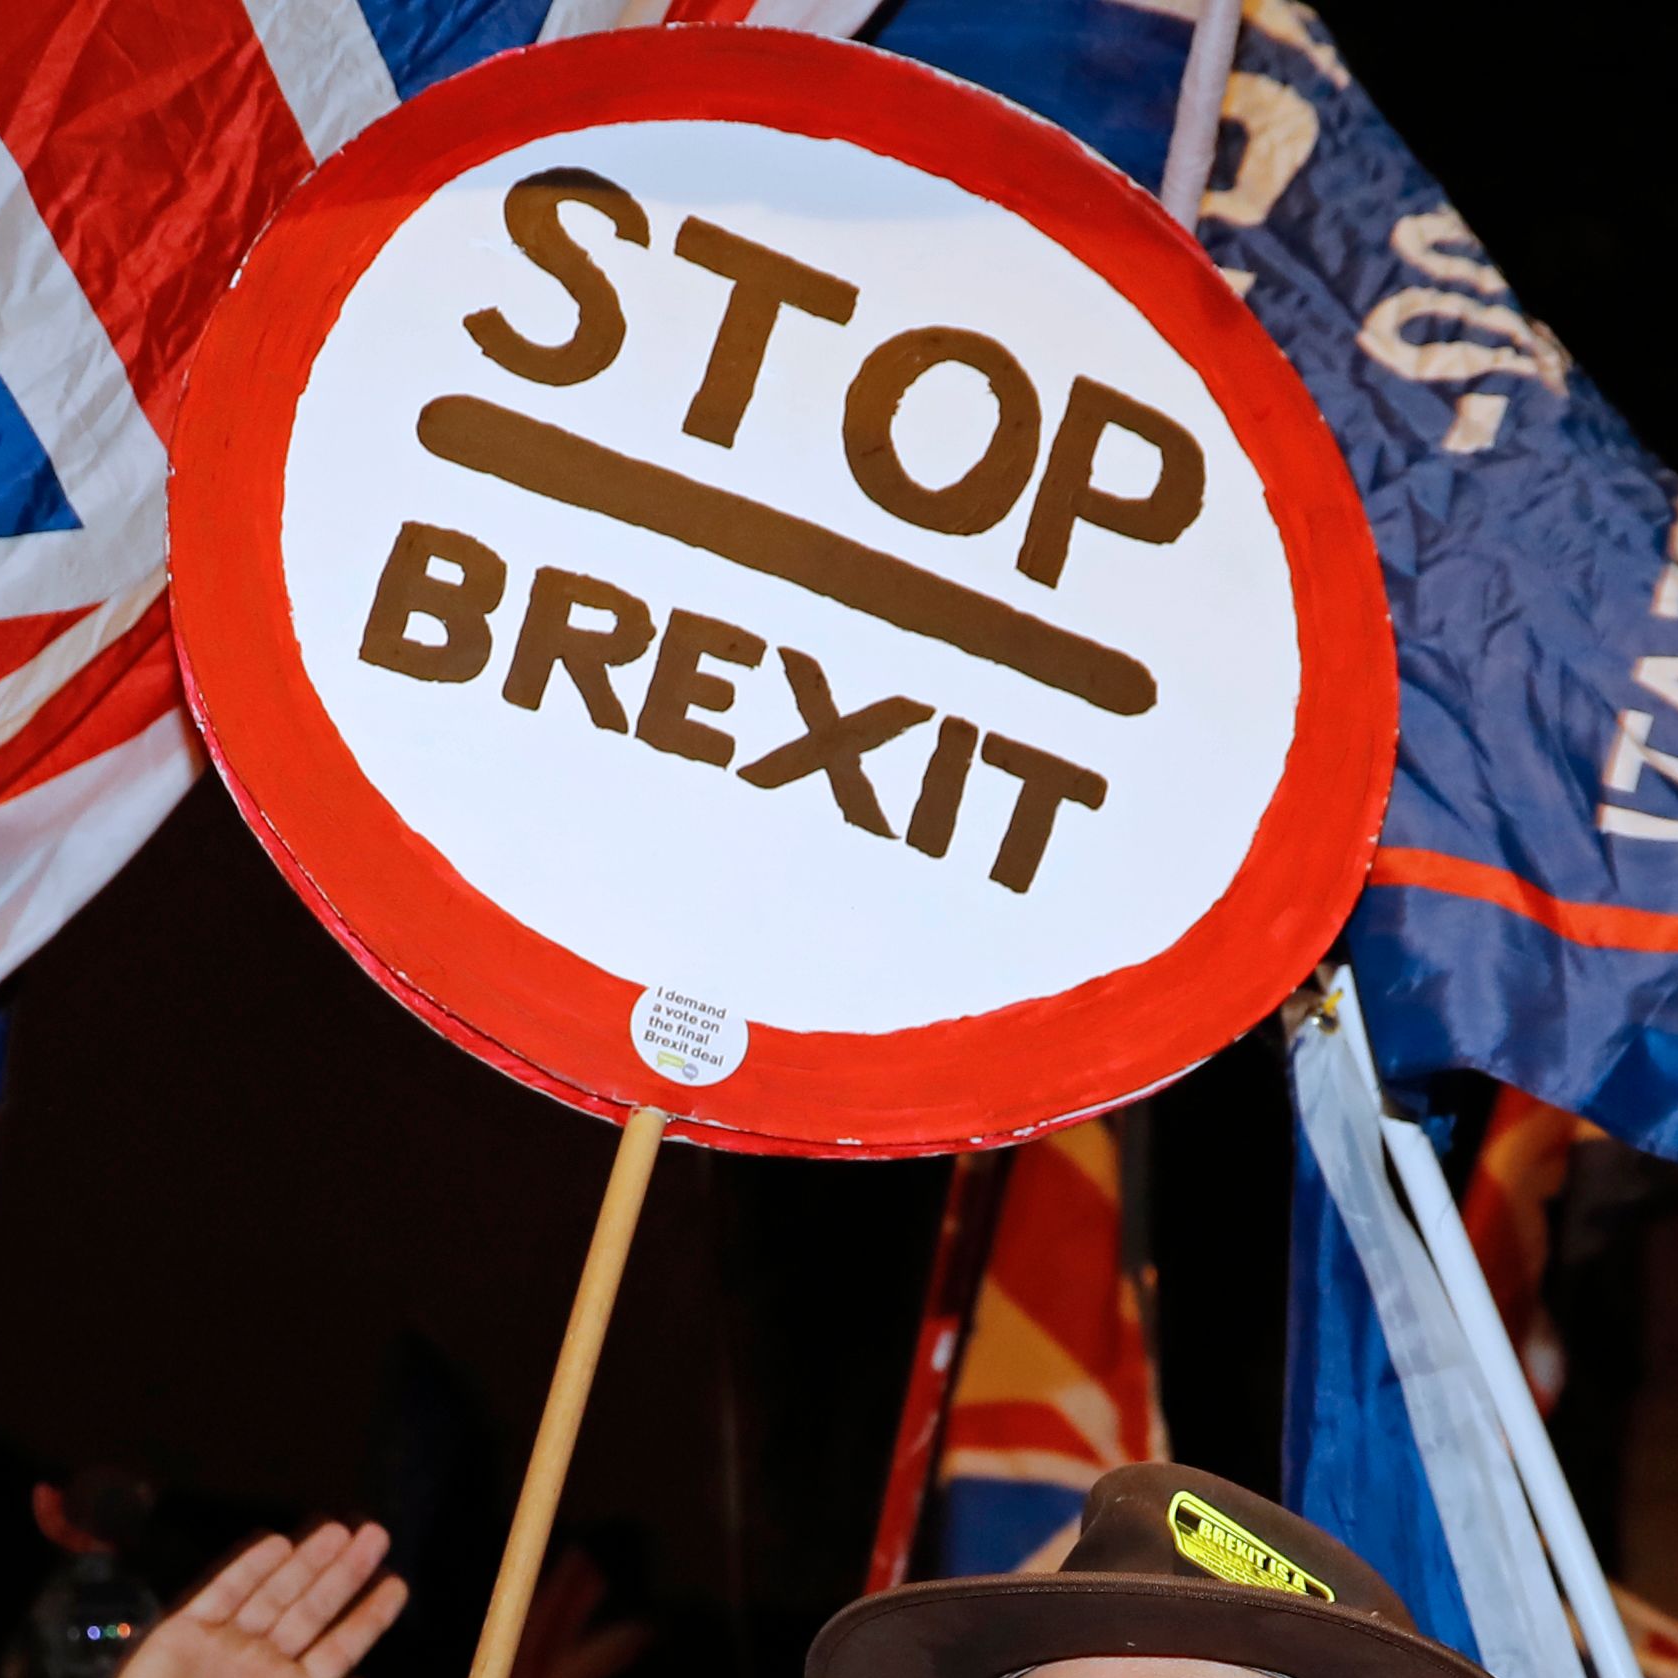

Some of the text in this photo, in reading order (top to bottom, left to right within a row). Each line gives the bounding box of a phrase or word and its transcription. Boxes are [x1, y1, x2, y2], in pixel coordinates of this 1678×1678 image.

[464, 168, 1205, 589] STOP
[359, 522, 1107, 893] BREXIT
[653, 1003, 720, 1034] a vote on
[657, 986, 727, 1019] I demand
[644, 1030, 689, 1054] Brexit
[691, 1047, 724, 1067] deal
[649, 1016, 710, 1045] the final
[1197, 1518, 1307, 1592] BREXIT IS A
